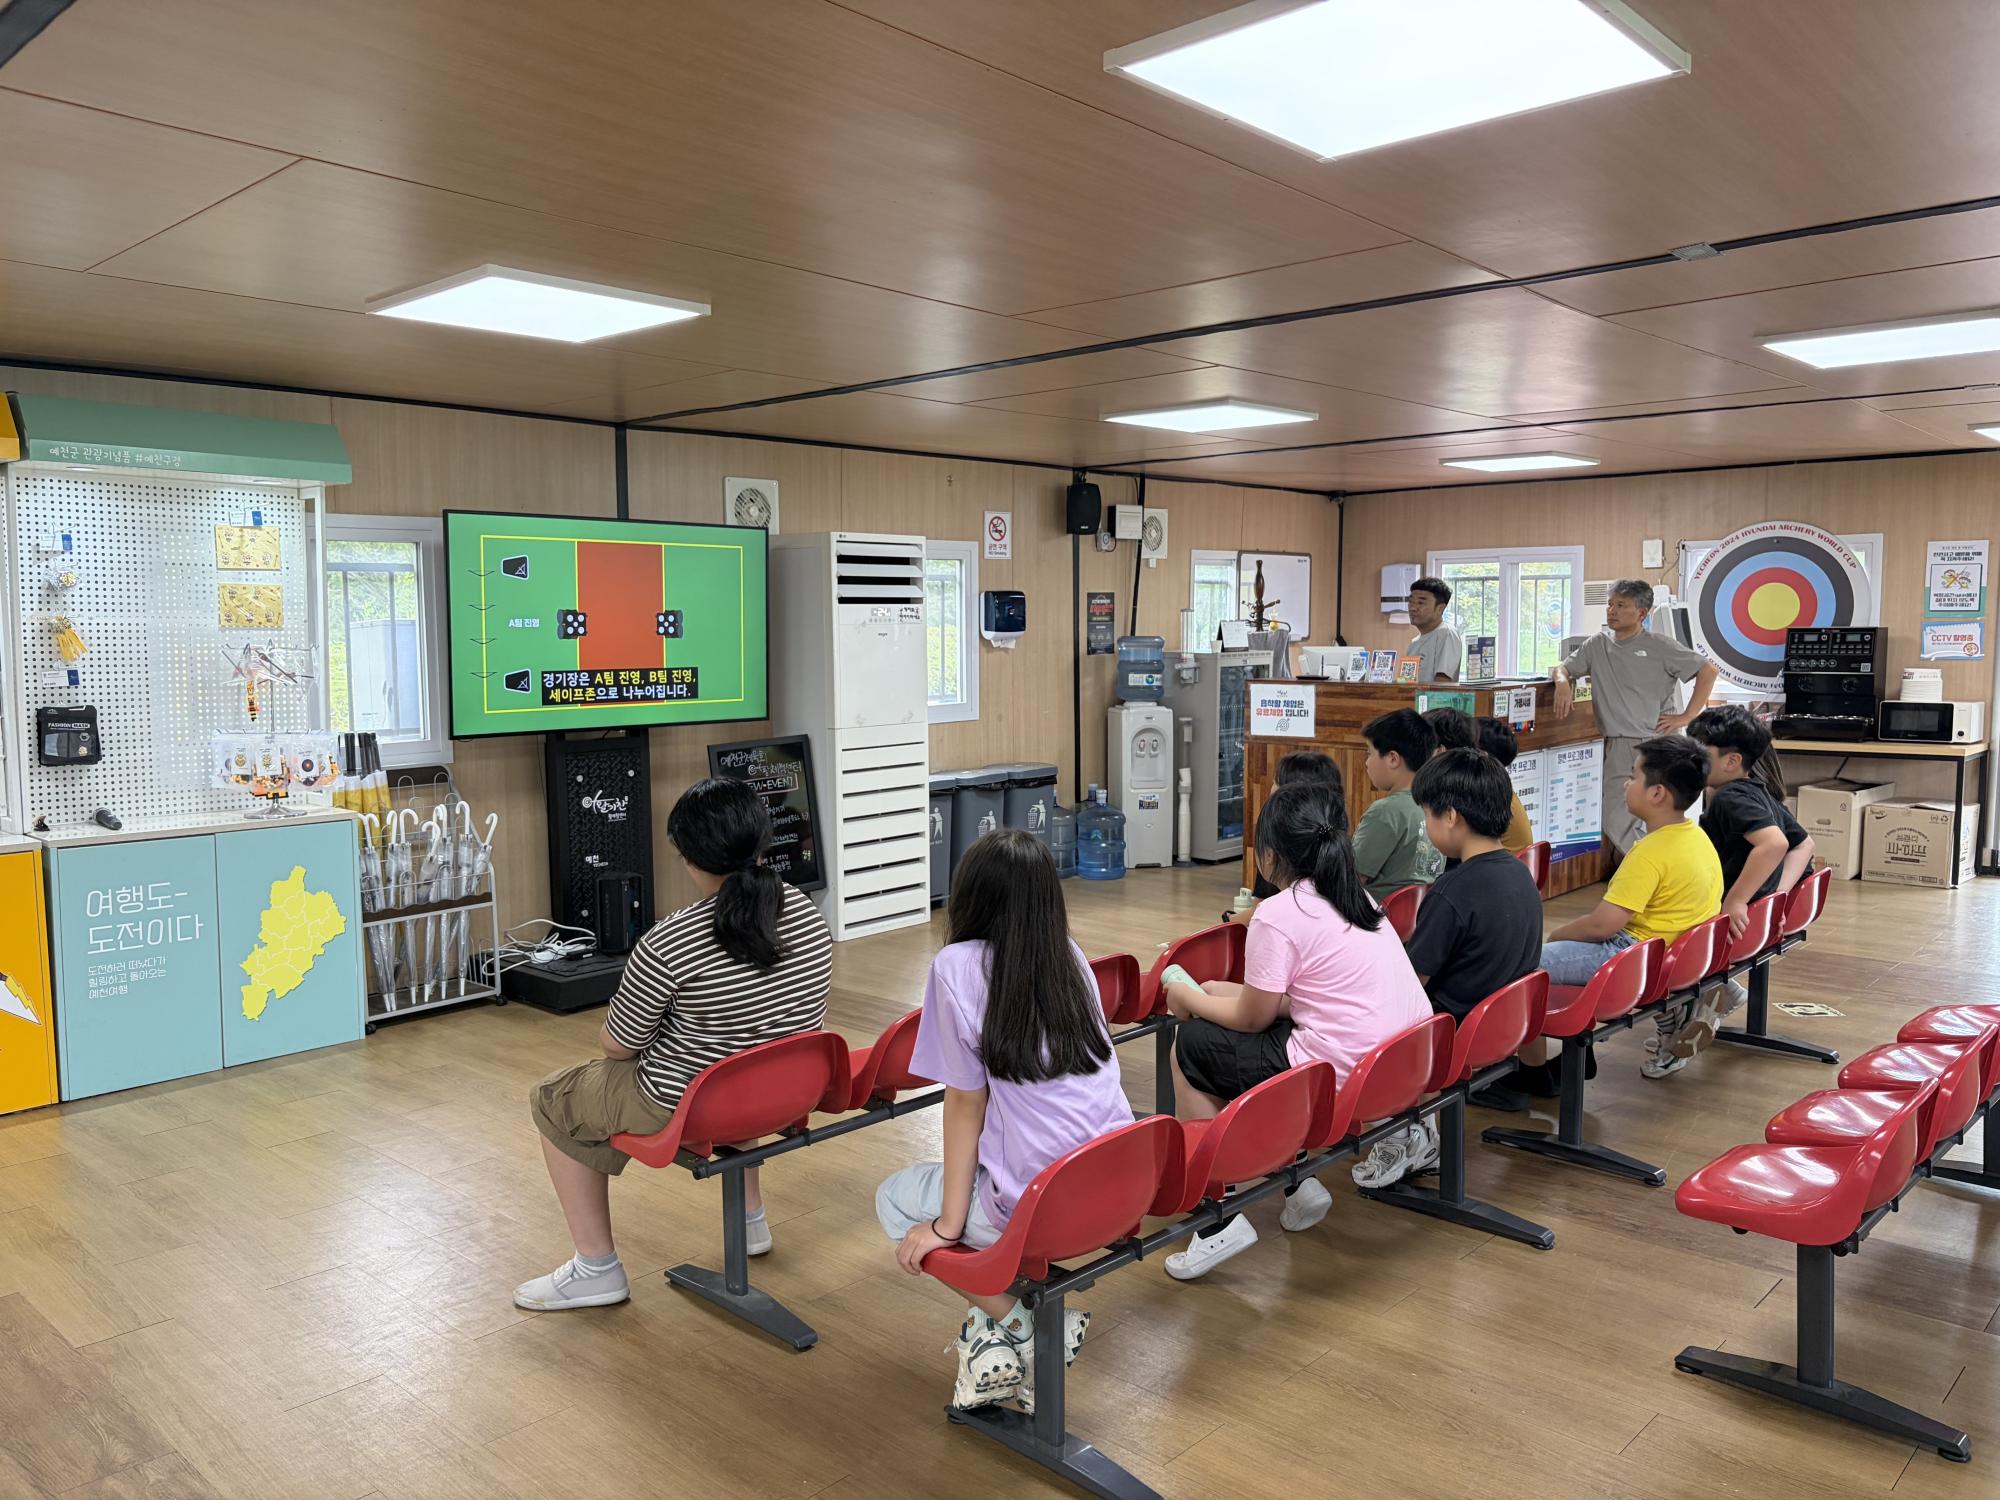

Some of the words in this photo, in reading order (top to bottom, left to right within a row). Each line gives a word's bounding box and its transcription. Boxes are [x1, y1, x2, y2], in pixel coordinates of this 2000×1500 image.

[49, 445, 79, 460] 예천군
[83, 447, 131, 464] 관광기념품
[1694, 547, 1720, 580] YECHEON
[1720, 534, 1740, 550] 2024
[1742, 525, 1776, 537] HYUNDAI
[1778, 525, 1816, 536] ARCHERY
[1817, 532, 1844, 554] WORLD
[1843, 552, 1857, 569] CUP
[1931, 634, 1952, 642] CCTV
[543, 671, 591, 688] 경기장은
[594, 671, 615, 686] A팀
[618, 670, 645, 685] 진영,
[649, 669, 667, 684] B팀
[671, 668, 697, 683] 진영,
[549, 686, 619, 703] 세이프존으로
[622, 683, 692, 700] 나누어집니다.
[88, 914, 204, 954] 도전이다
